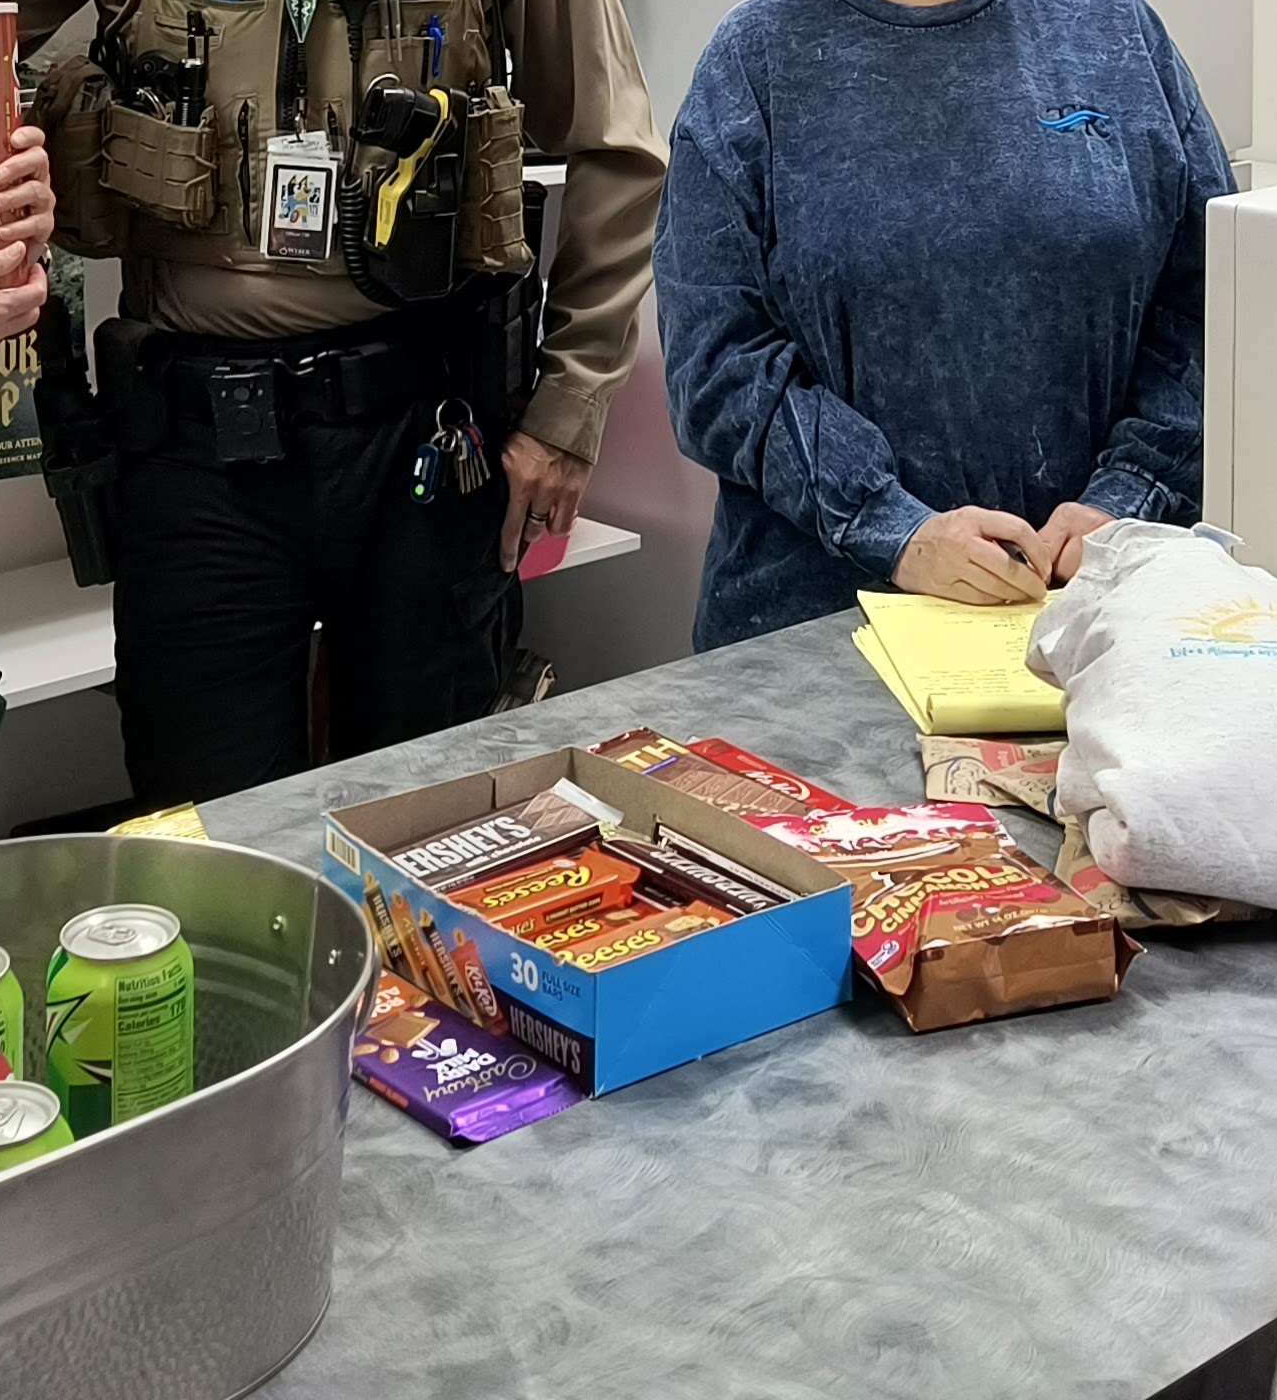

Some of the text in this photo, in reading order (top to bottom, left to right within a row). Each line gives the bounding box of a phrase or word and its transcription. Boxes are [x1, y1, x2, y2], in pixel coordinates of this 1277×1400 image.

[391, 816, 533, 879] ERSHEY'S
[482, 866, 591, 908] Reese's
[851, 863, 1025, 938] CHOCOLA
[881, 880, 992, 934] CINNAMON
[372, 894, 403, 959] HERSHEY'S
[534, 917, 602, 949] ese's
[953, 923, 972, 932] NET
[973, 919, 991, 930] WT
[429, 930, 465, 998] HERSHEY'S
[510, 952, 539, 992] 30
[542, 970, 582, 998] FULL SIZE
[118, 976, 162, 993] Nutrition
[542, 982, 564, 1001] BARS
[118, 1016, 161, 1032] Calories
[509, 1005, 581, 1075] HERSHEY'S
[424, 1053, 538, 1103] Cadbury
[426, 1047, 480, 1072] MILK
[435, 1052, 497, 1085] DAIRY
